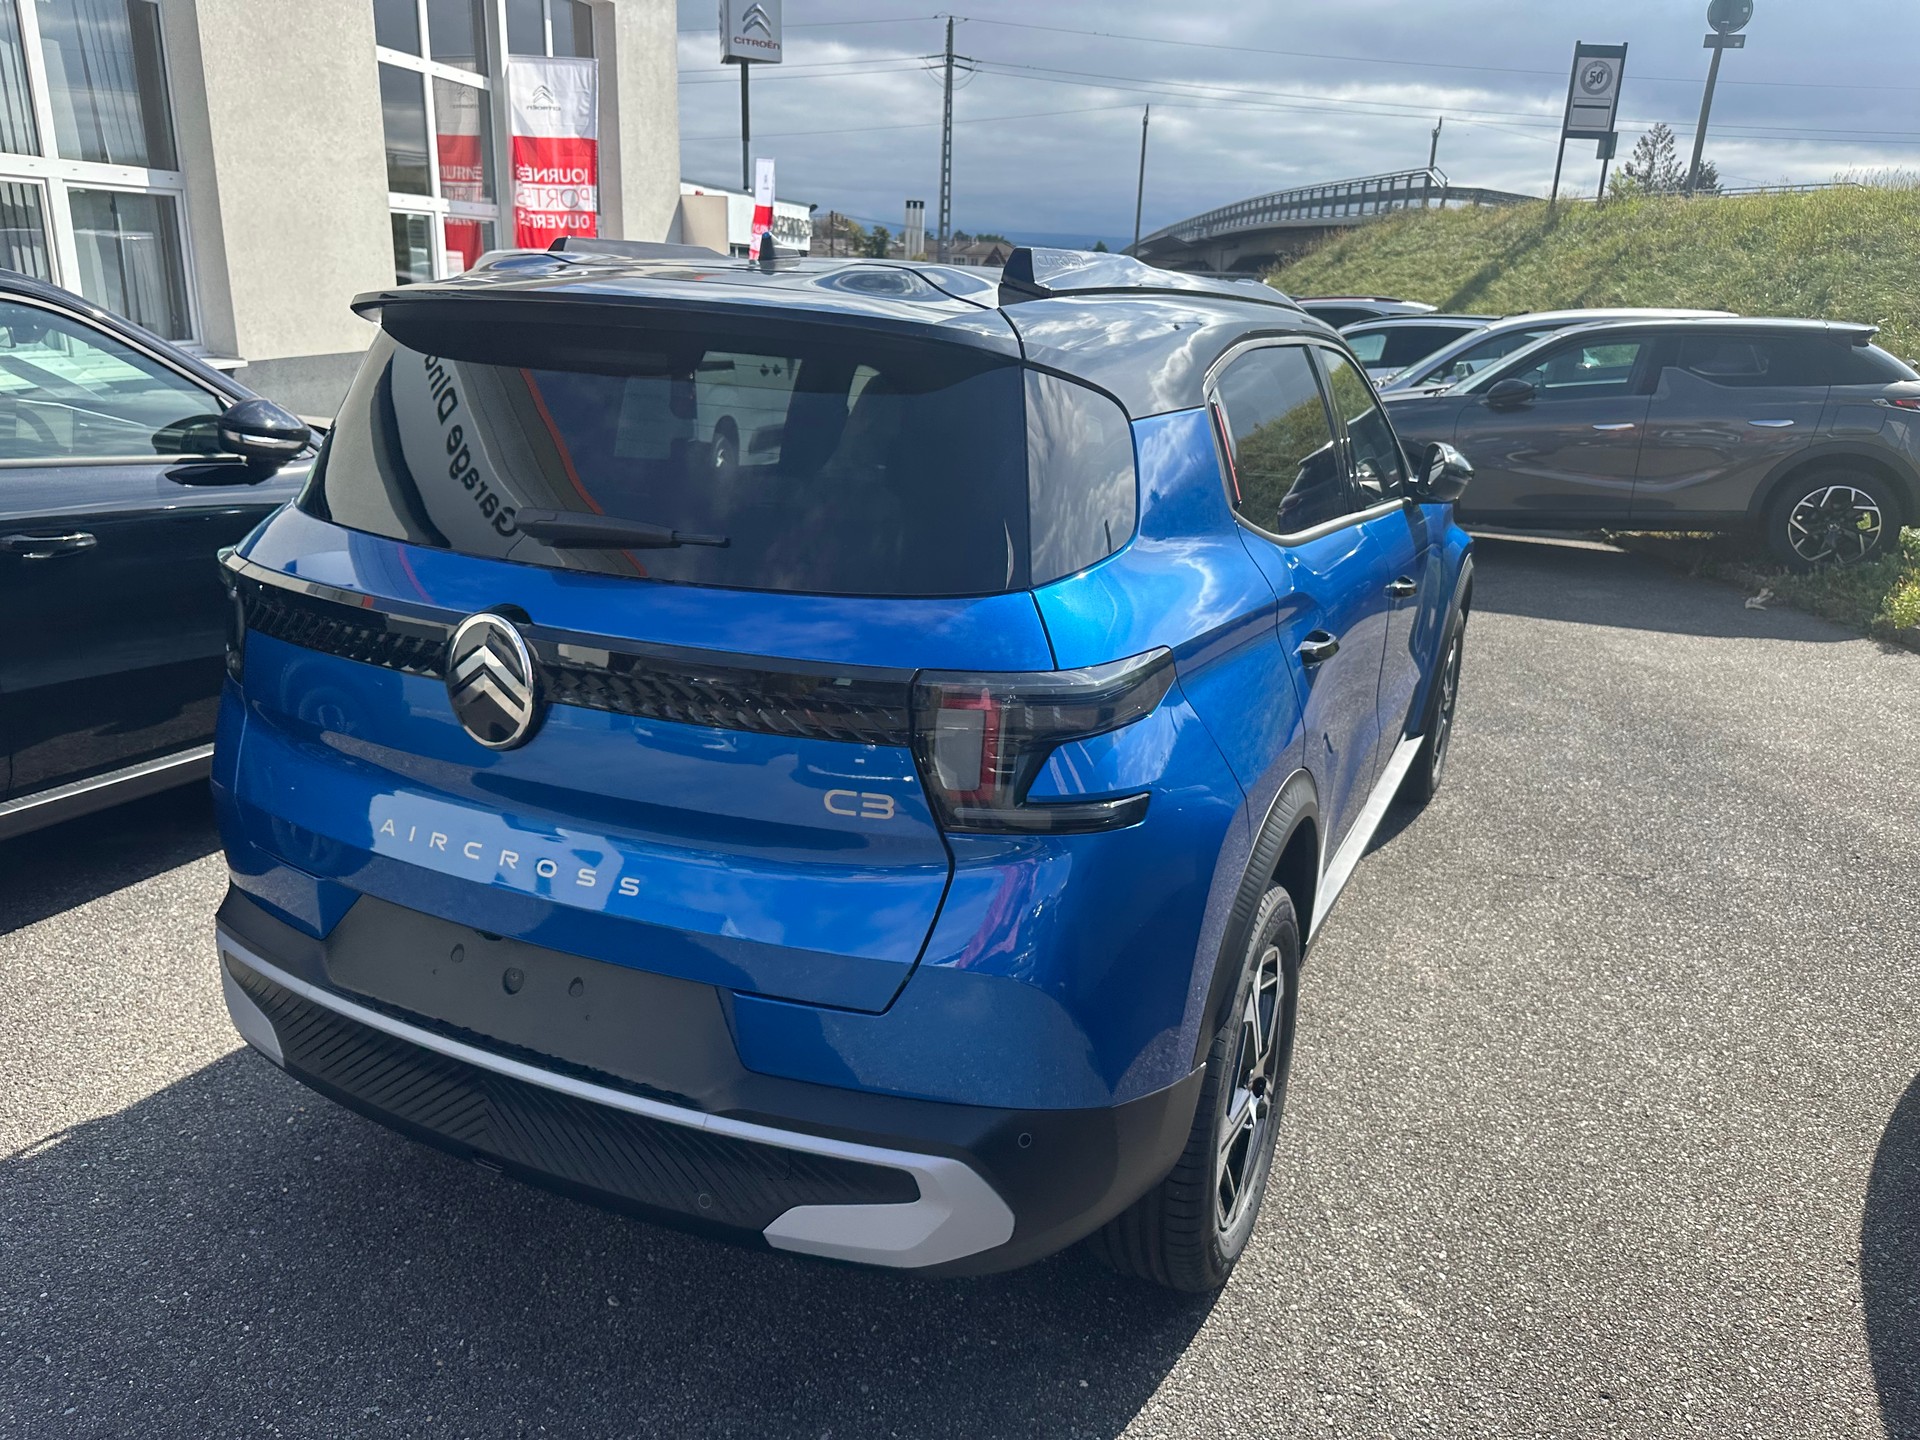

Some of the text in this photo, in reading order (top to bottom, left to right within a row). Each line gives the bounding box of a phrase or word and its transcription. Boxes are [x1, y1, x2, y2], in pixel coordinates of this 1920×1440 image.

[1589, 71, 1603, 84] 50
[823, 789, 895, 819] C3
[379, 818, 641, 897] AIRCROSS
